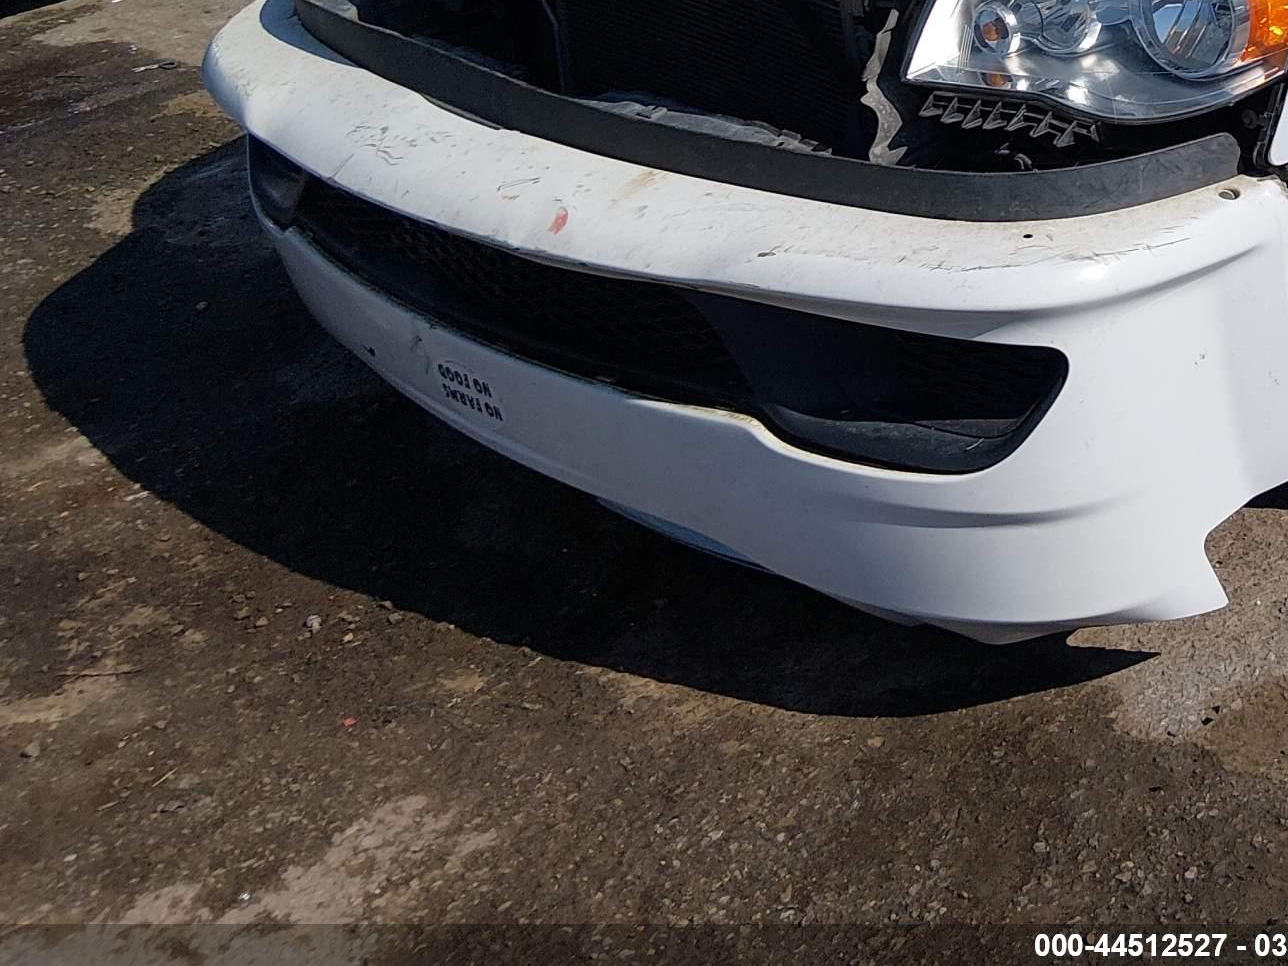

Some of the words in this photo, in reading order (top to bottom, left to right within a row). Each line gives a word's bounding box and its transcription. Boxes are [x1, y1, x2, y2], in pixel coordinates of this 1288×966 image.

[438, 363, 471, 389] FOOD
[442, 382, 483, 412] FARMS
[472, 378, 492, 398] NO
[484, 401, 503, 421] NO
